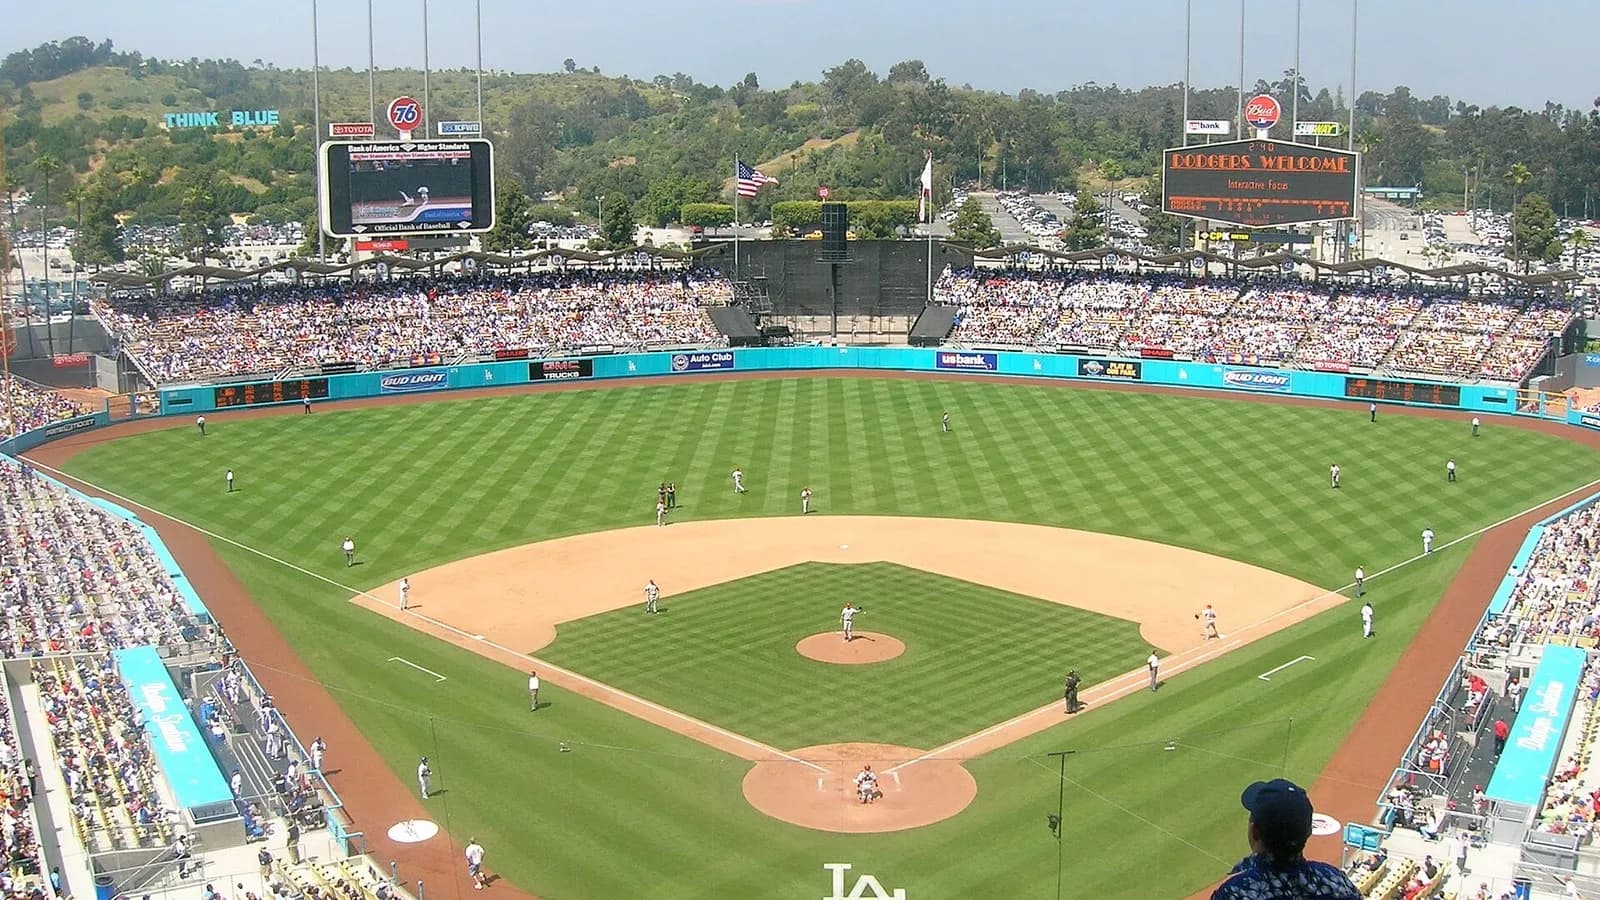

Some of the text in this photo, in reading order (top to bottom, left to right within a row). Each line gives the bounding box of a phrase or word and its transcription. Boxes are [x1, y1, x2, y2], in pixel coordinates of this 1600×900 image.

[394, 103, 418, 123] 76
[1248, 104, 1275, 116] Bud
[164, 110, 279, 128] THINK BLUE
[1297, 123, 1334, 134] SUBWAY
[348, 144, 399, 152] Bank of America
[417, 142, 470, 152] Higher Standards
[1171, 153, 1349, 171] DODGERS WELCOME
[1228, 179, 1289, 190] Interactive Focus
[399, 223, 415, 231] Bank
[424, 222, 451, 230] Baseball
[690, 352, 732, 362] Auto Club
[543, 361, 579, 370] GMC
[1324, 361, 1348, 370] TOYOTA
[383, 373, 446, 386] BUD LIGHT
[484, 369, 493, 380] LA
[543, 371, 580, 379] TRUCKS
[1226, 373, 1289, 385] BUD LIGHT
[823, 863, 906, 900] LA
